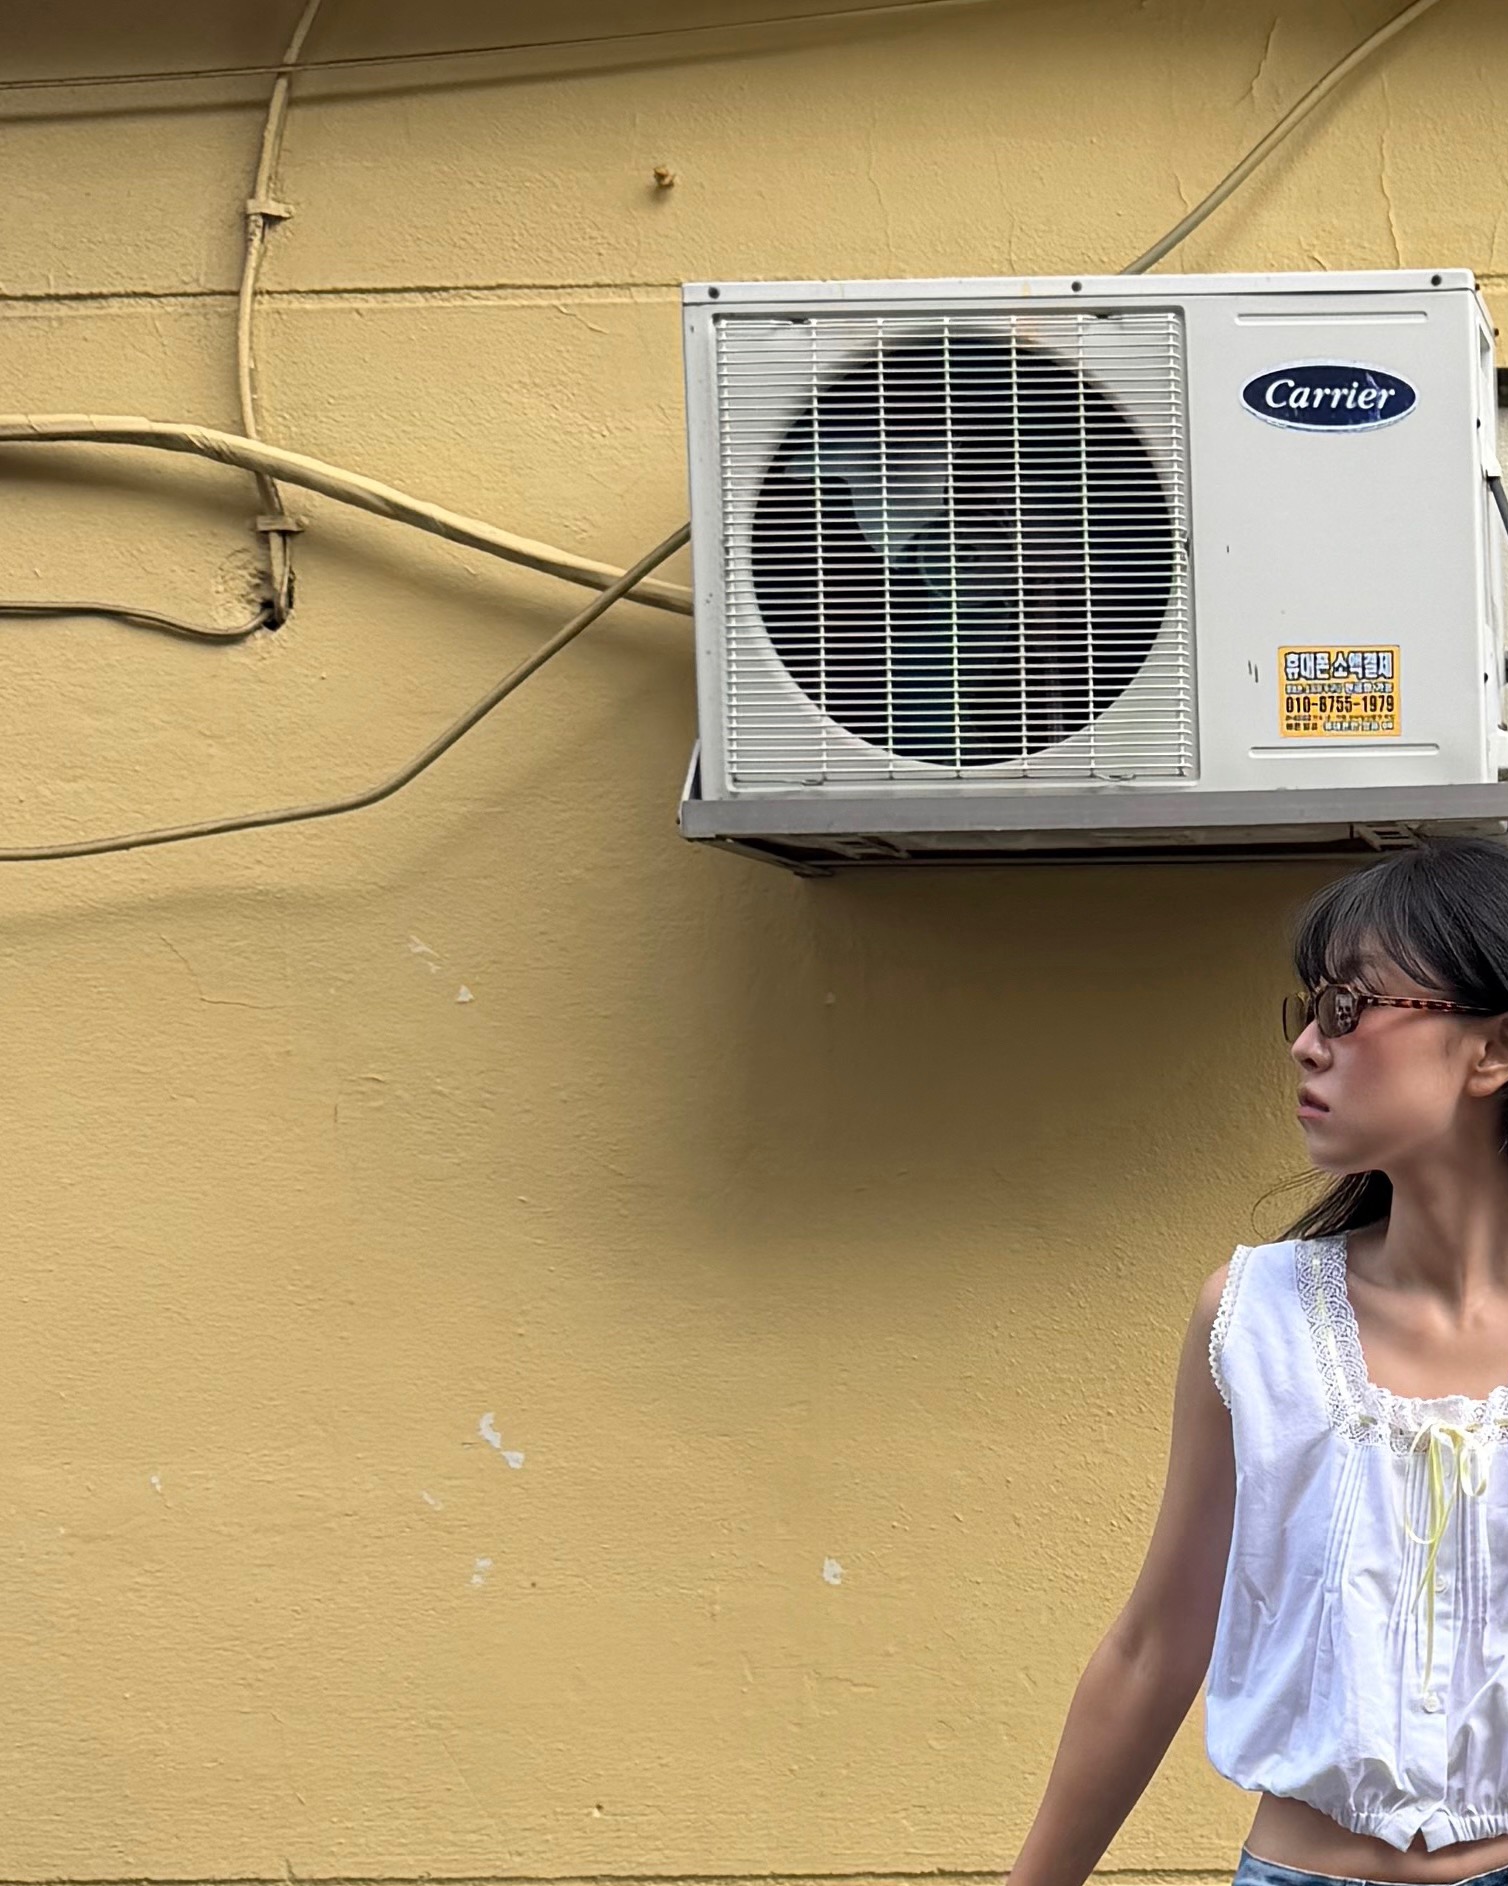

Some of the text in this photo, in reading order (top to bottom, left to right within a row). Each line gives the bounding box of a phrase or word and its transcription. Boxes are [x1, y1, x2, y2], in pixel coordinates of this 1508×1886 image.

[1265, 378, 1396, 410] Carrier
[1284, 650, 1394, 681] 휴대폰 소액결제
